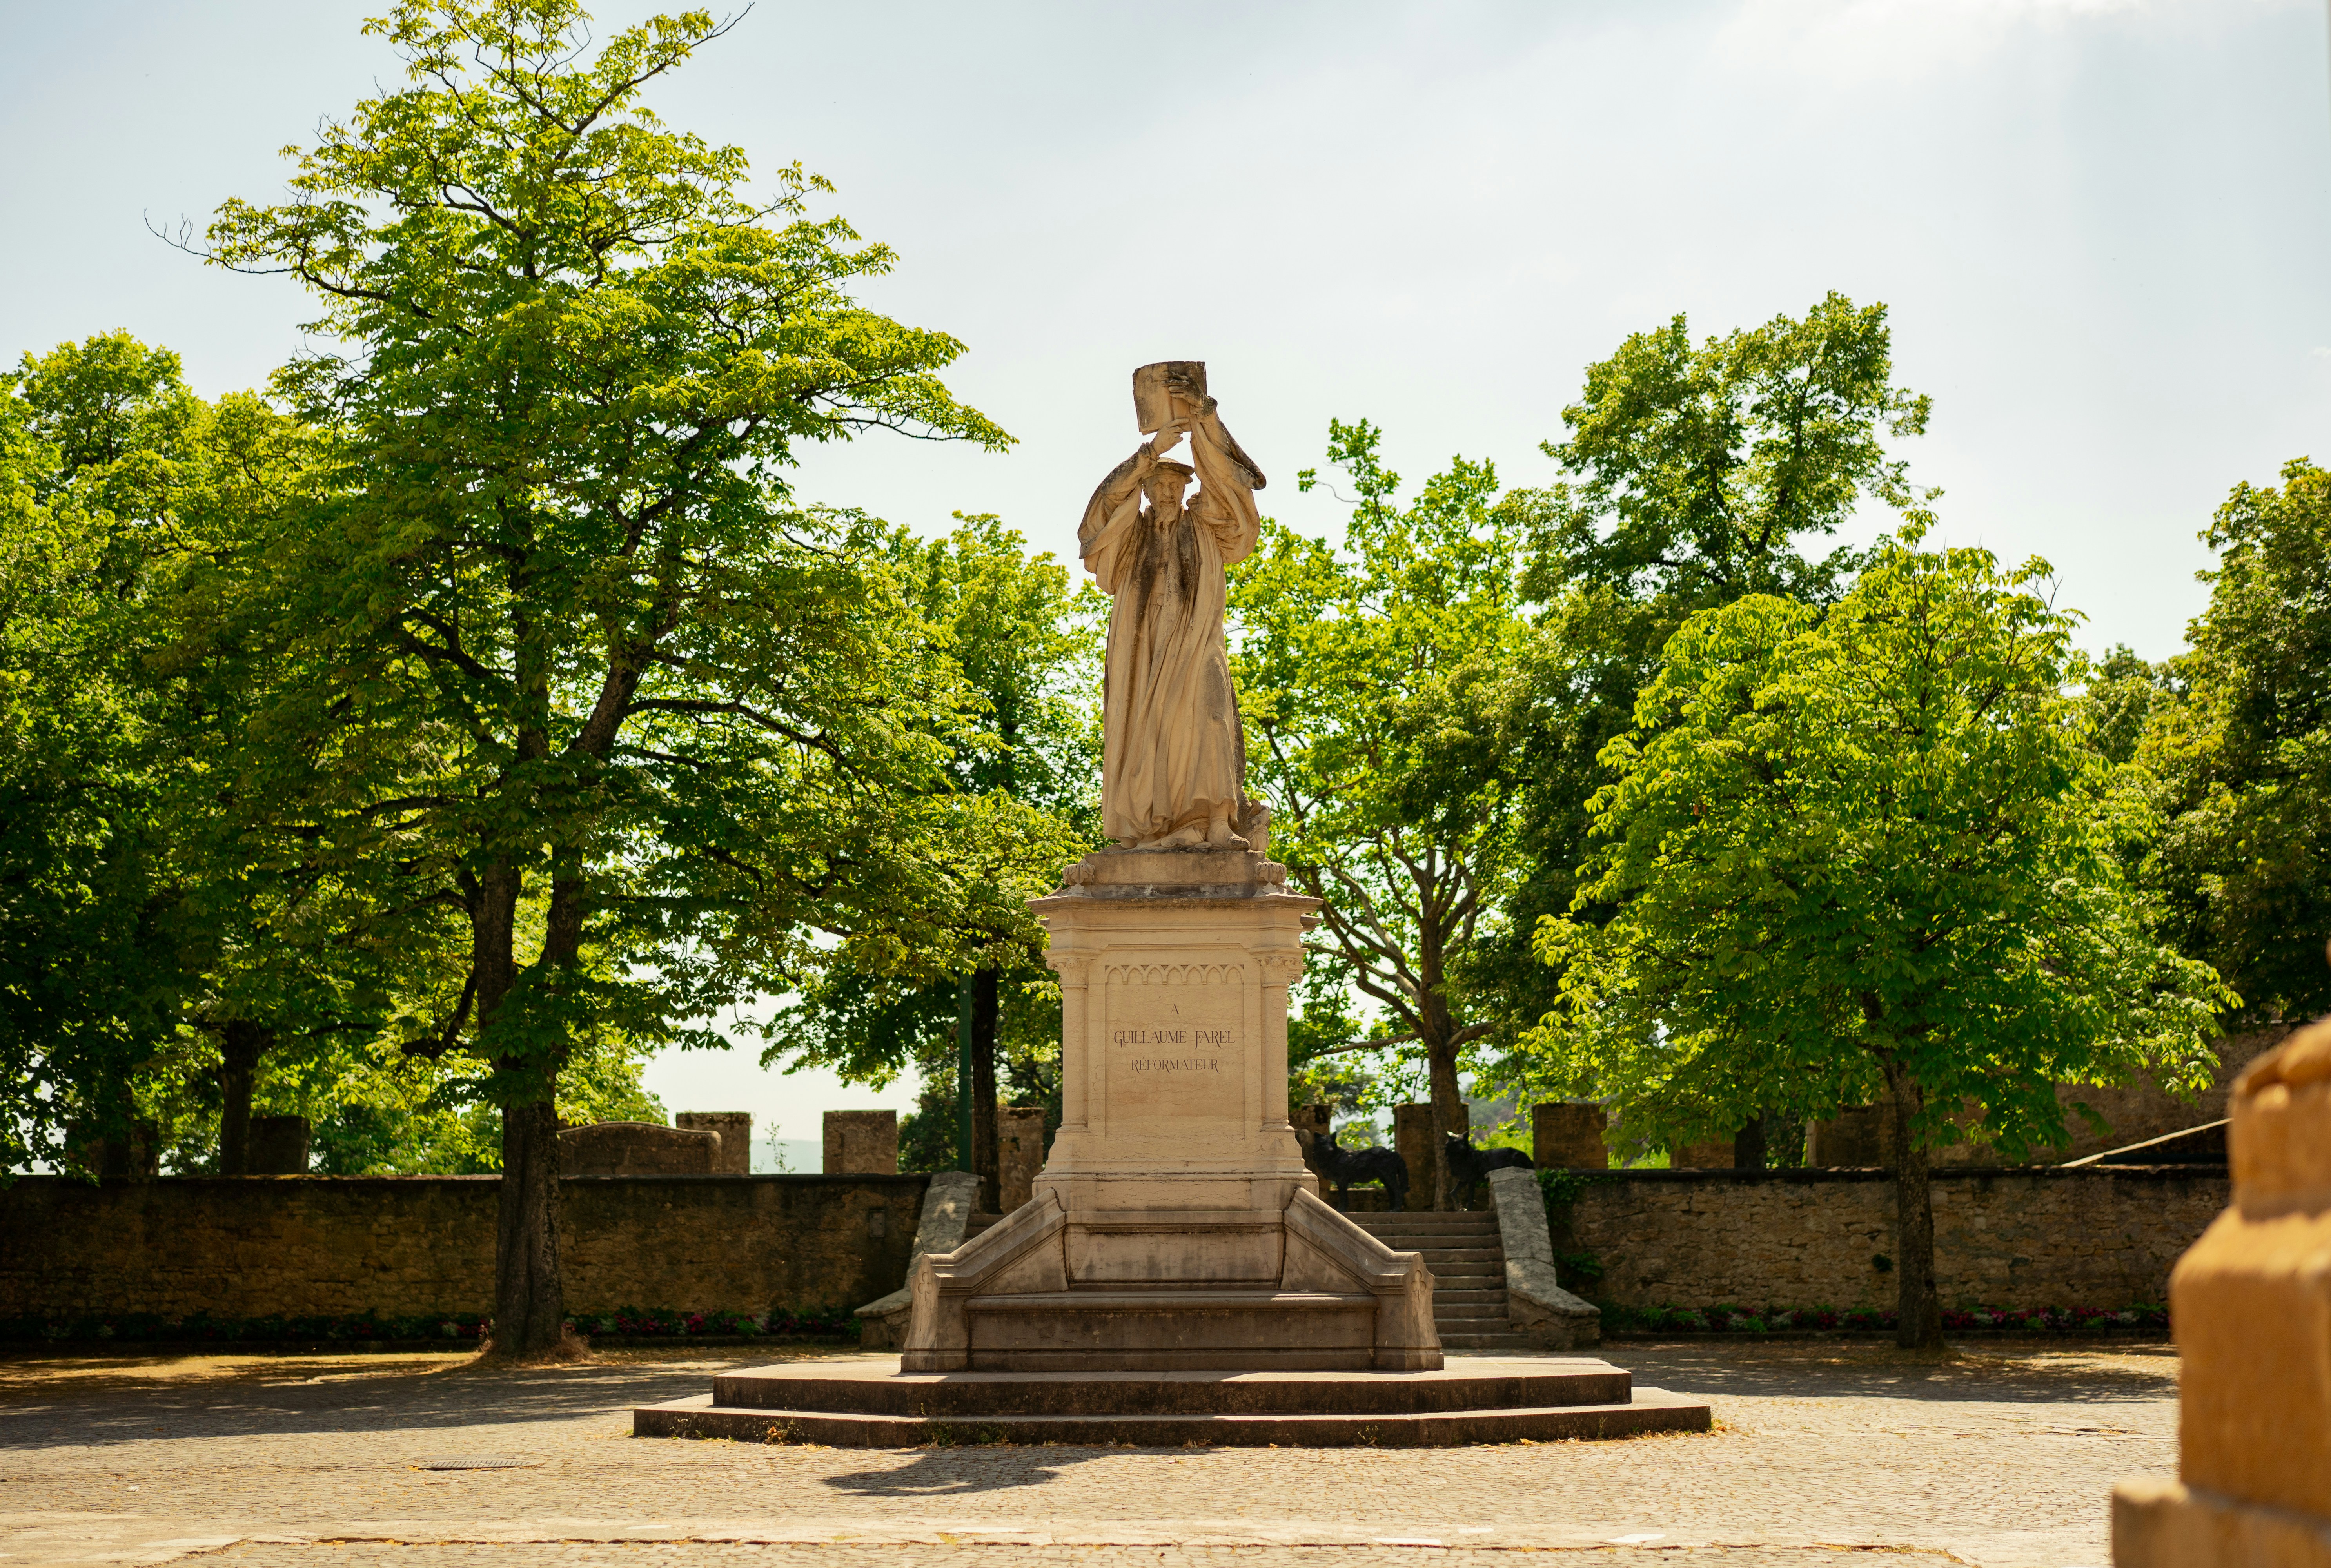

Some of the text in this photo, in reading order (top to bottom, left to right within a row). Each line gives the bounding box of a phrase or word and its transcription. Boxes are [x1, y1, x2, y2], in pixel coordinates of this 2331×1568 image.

[1170, 1004, 1179, 1014] A
[1114, 1031, 1235, 1050] GUILLAUME FAREL
[1131, 1057, 1220, 1074] RÉFORMATEUR
